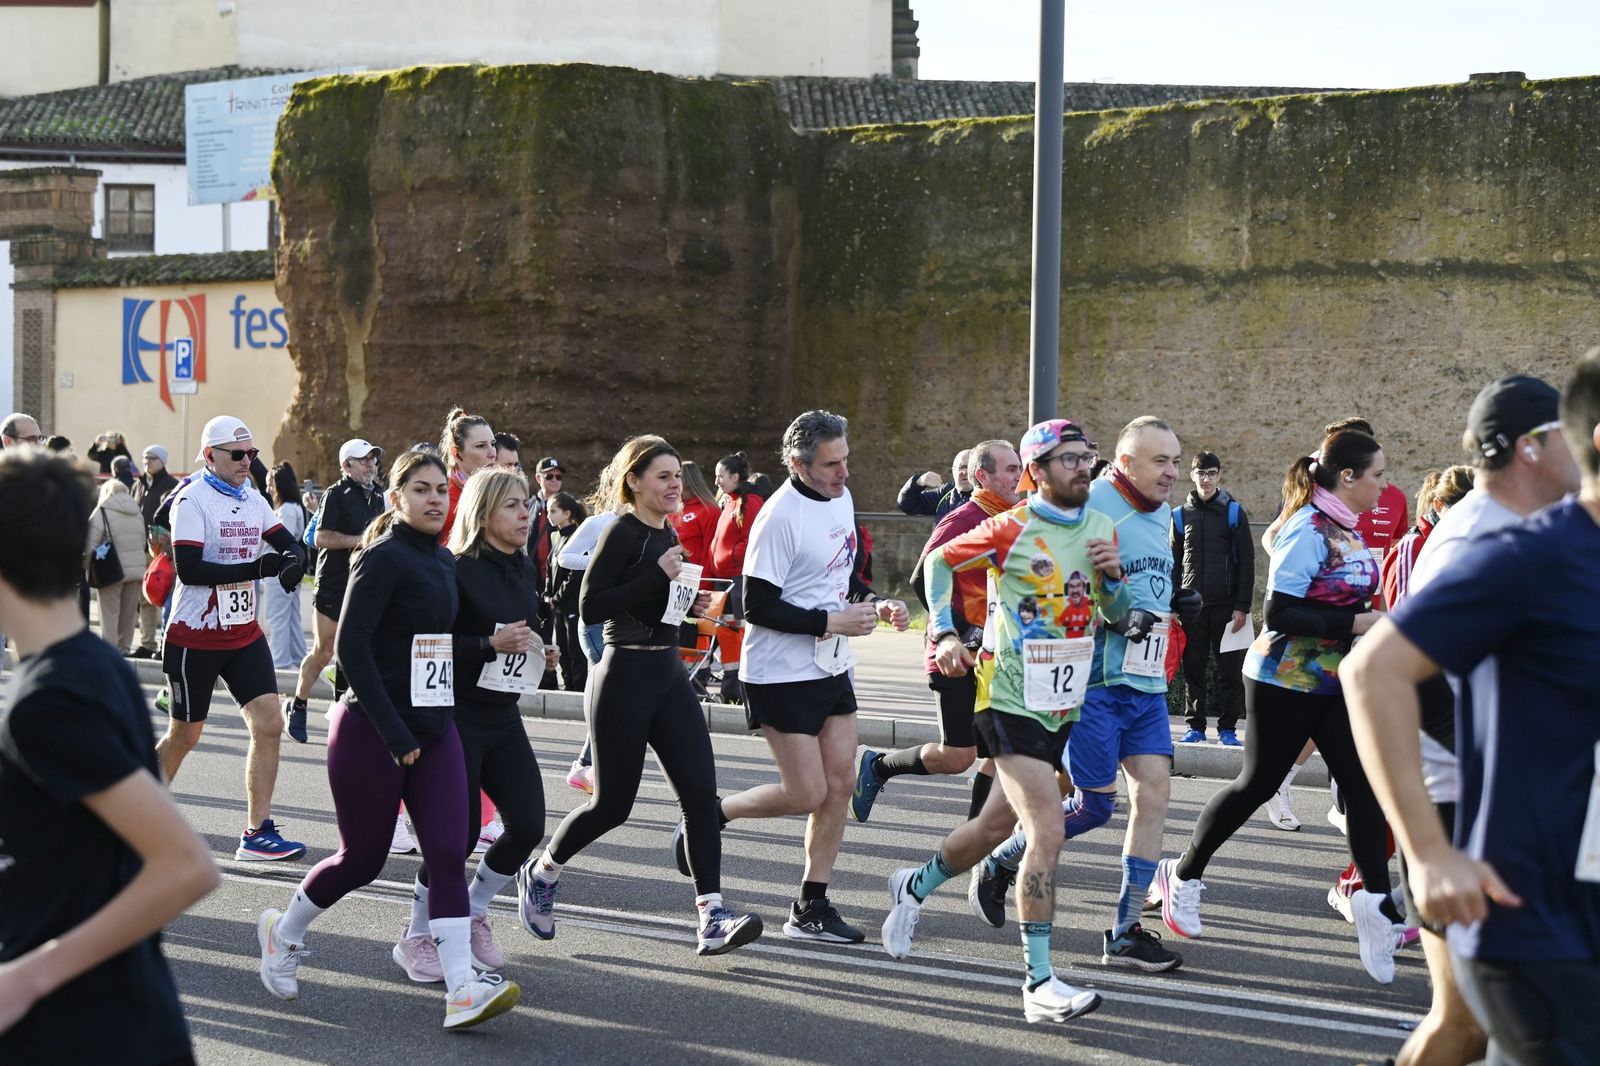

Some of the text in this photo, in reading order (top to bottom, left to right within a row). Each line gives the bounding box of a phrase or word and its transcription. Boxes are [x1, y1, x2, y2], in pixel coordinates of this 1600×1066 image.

[177, 341, 190, 365] P
[220, 525, 260, 537] MEDIA MARATÓN
[1147, 556, 1159, 571] POR
[1344, 573, 1371, 586] GRIS
[673, 584, 693, 611] 306
[502, 651, 528, 678] 92
[1026, 644, 1054, 664] XLII
[1050, 664, 1074, 694] 12
